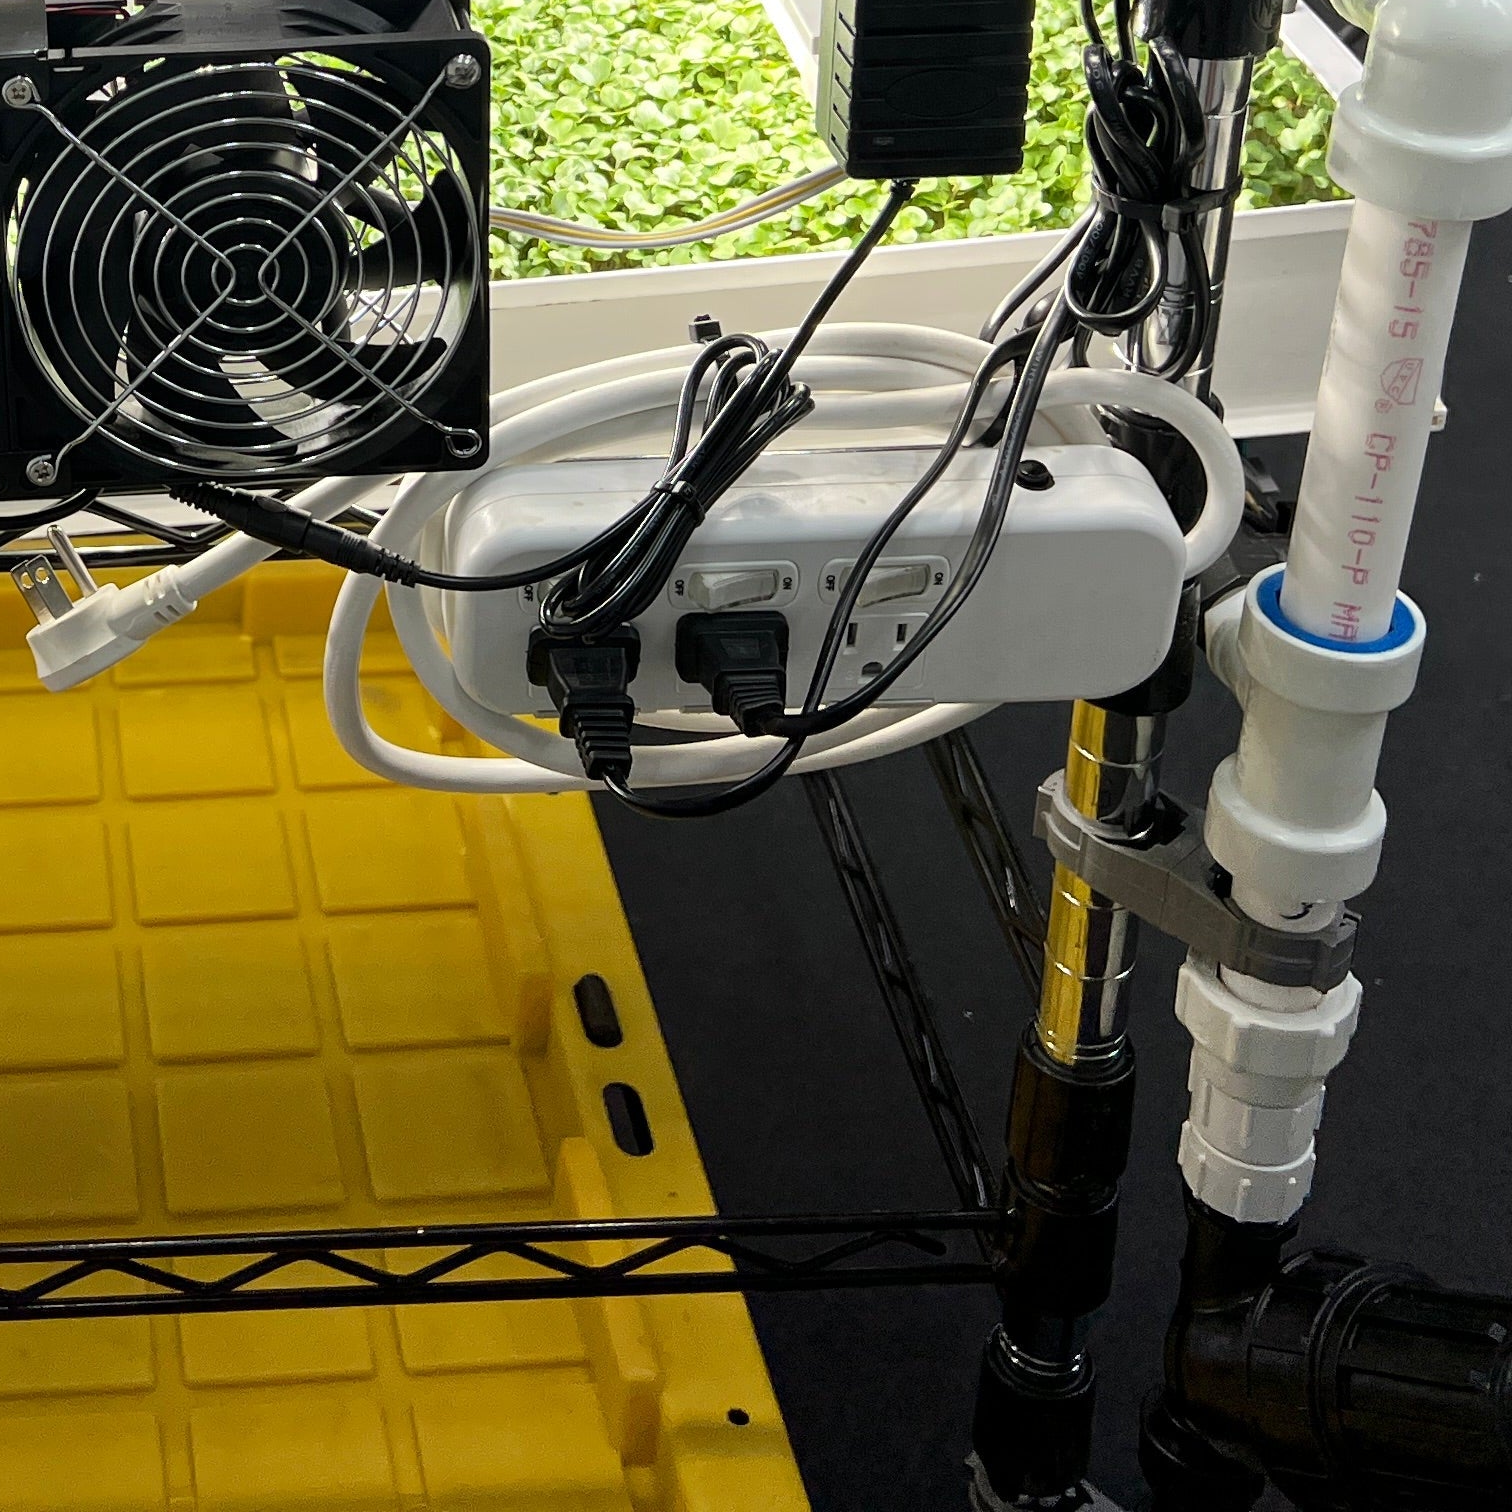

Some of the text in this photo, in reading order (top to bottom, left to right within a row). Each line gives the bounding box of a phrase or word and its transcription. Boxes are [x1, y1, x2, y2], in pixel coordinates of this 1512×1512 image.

[1341, 431, 1397, 586] CP-110-P
[782, 576, 793, 590] ON
[825, 574, 836, 592] OFF
[932, 571, 944, 586] ON
[674, 579, 685, 597] OFF
